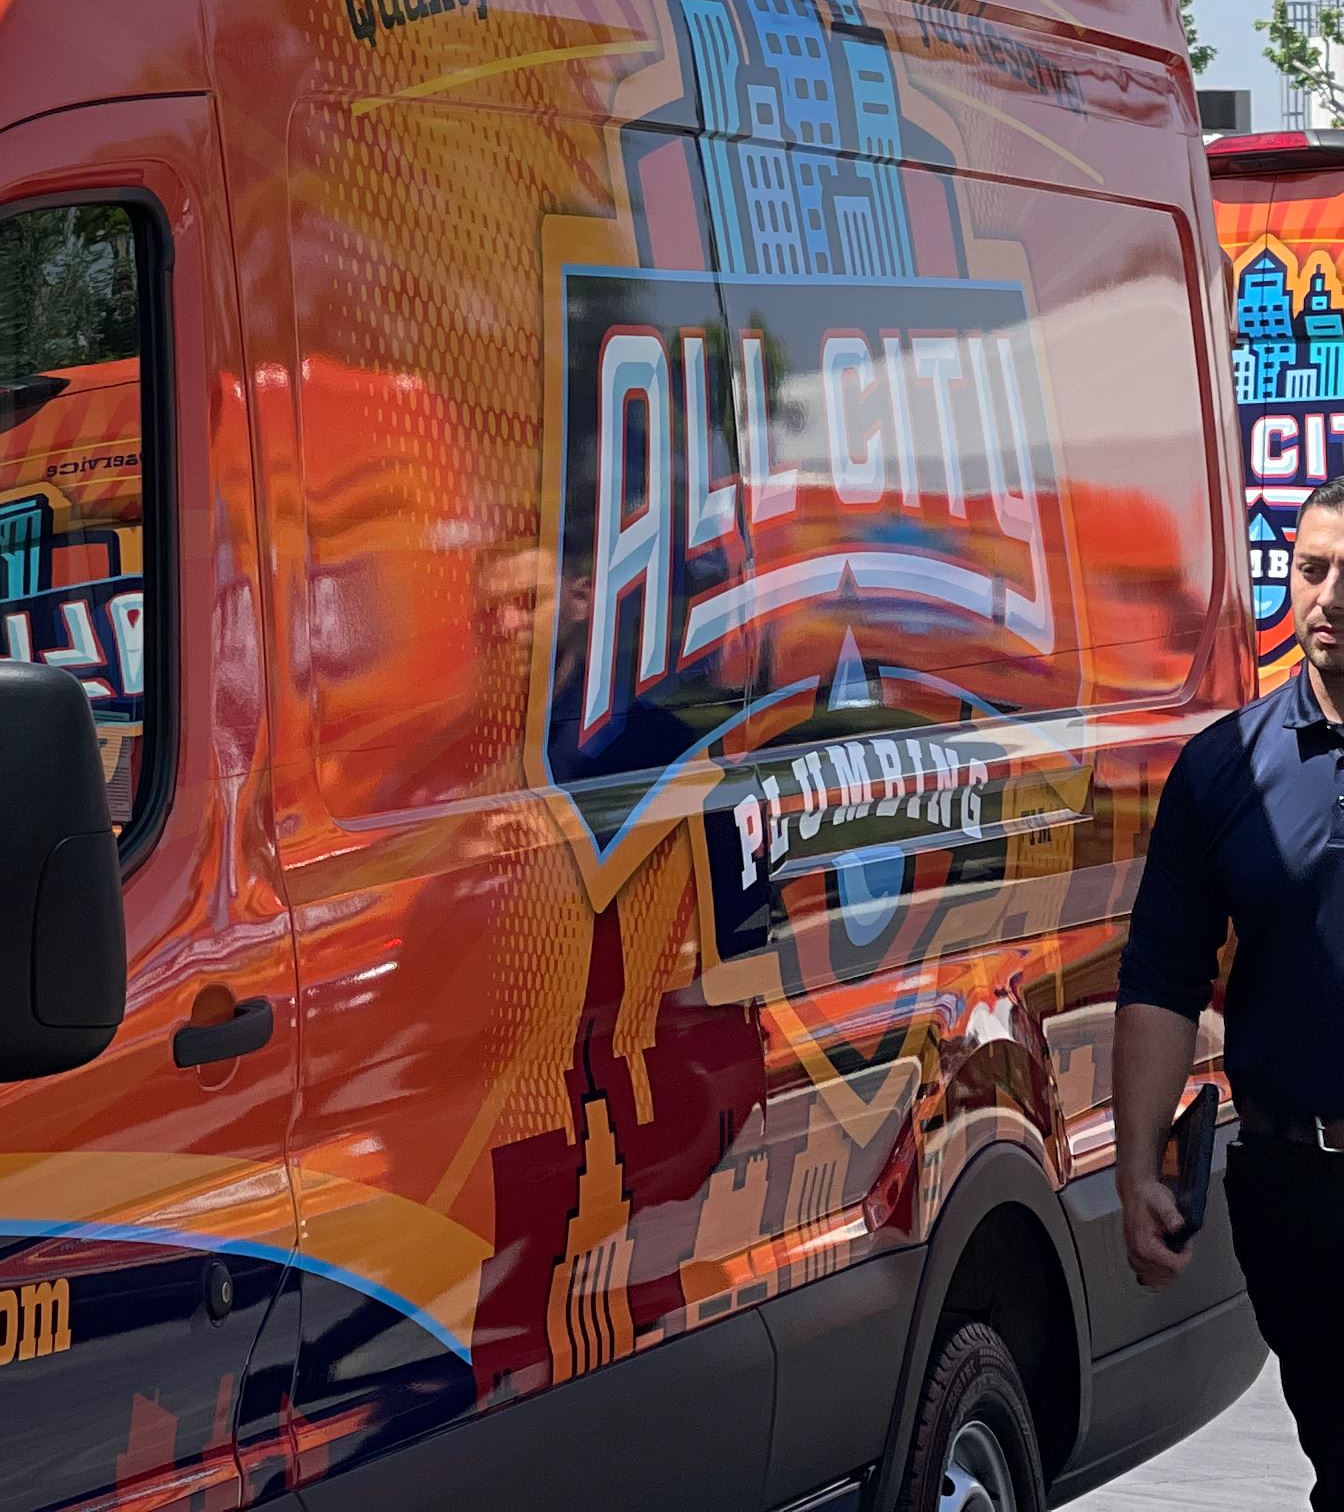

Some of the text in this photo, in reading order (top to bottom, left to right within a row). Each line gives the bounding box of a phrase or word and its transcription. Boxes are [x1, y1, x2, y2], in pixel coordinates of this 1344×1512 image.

[579, 325, 1056, 750] ALL CITY
[734, 738, 988, 891] PLUMBING
